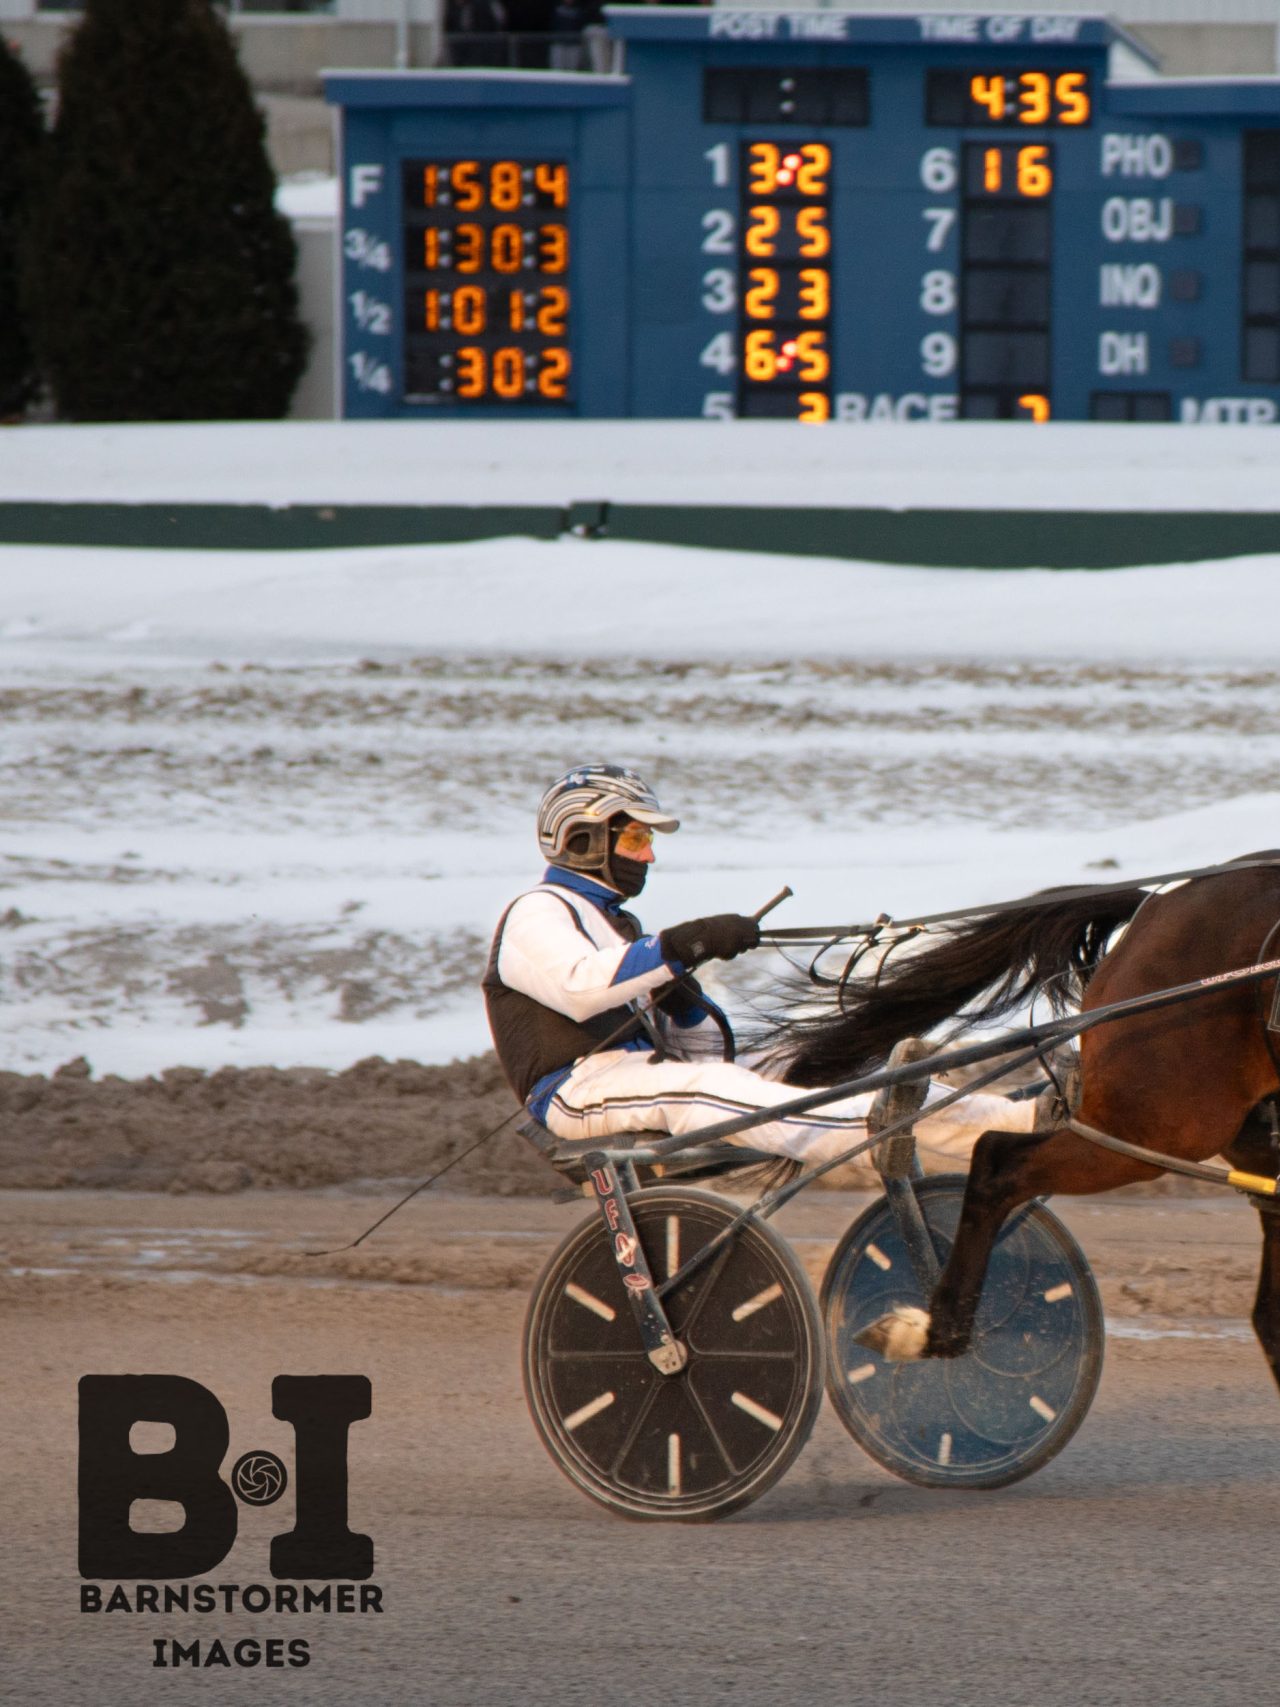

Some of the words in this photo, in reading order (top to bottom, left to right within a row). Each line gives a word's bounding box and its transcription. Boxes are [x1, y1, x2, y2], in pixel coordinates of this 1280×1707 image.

[709, 15, 779, 38] POST
[789, 16, 849, 39] TIME
[917, 16, 979, 39] TIME
[987, 17, 1024, 39] OF
[1030, 17, 1082, 40] DAY
[970, 71, 1090, 125] 4:35
[705, 143, 729, 187] 1
[921, 147, 957, 193] 6
[1101, 133, 1173, 179] PHO
[350, 164, 383, 208] F
[702, 209, 735, 254] 2
[923, 207, 957, 252] 7
[1101, 197, 1172, 242] OBJ
[702, 268, 737, 314] 3
[920, 269, 957, 316] 8
[1100, 262, 1162, 309] INQ
[701, 331, 736, 375] 4
[921, 331, 957, 378] 9
[1100, 331, 1148, 376] DH
[836, 392, 959, 420] RACE
